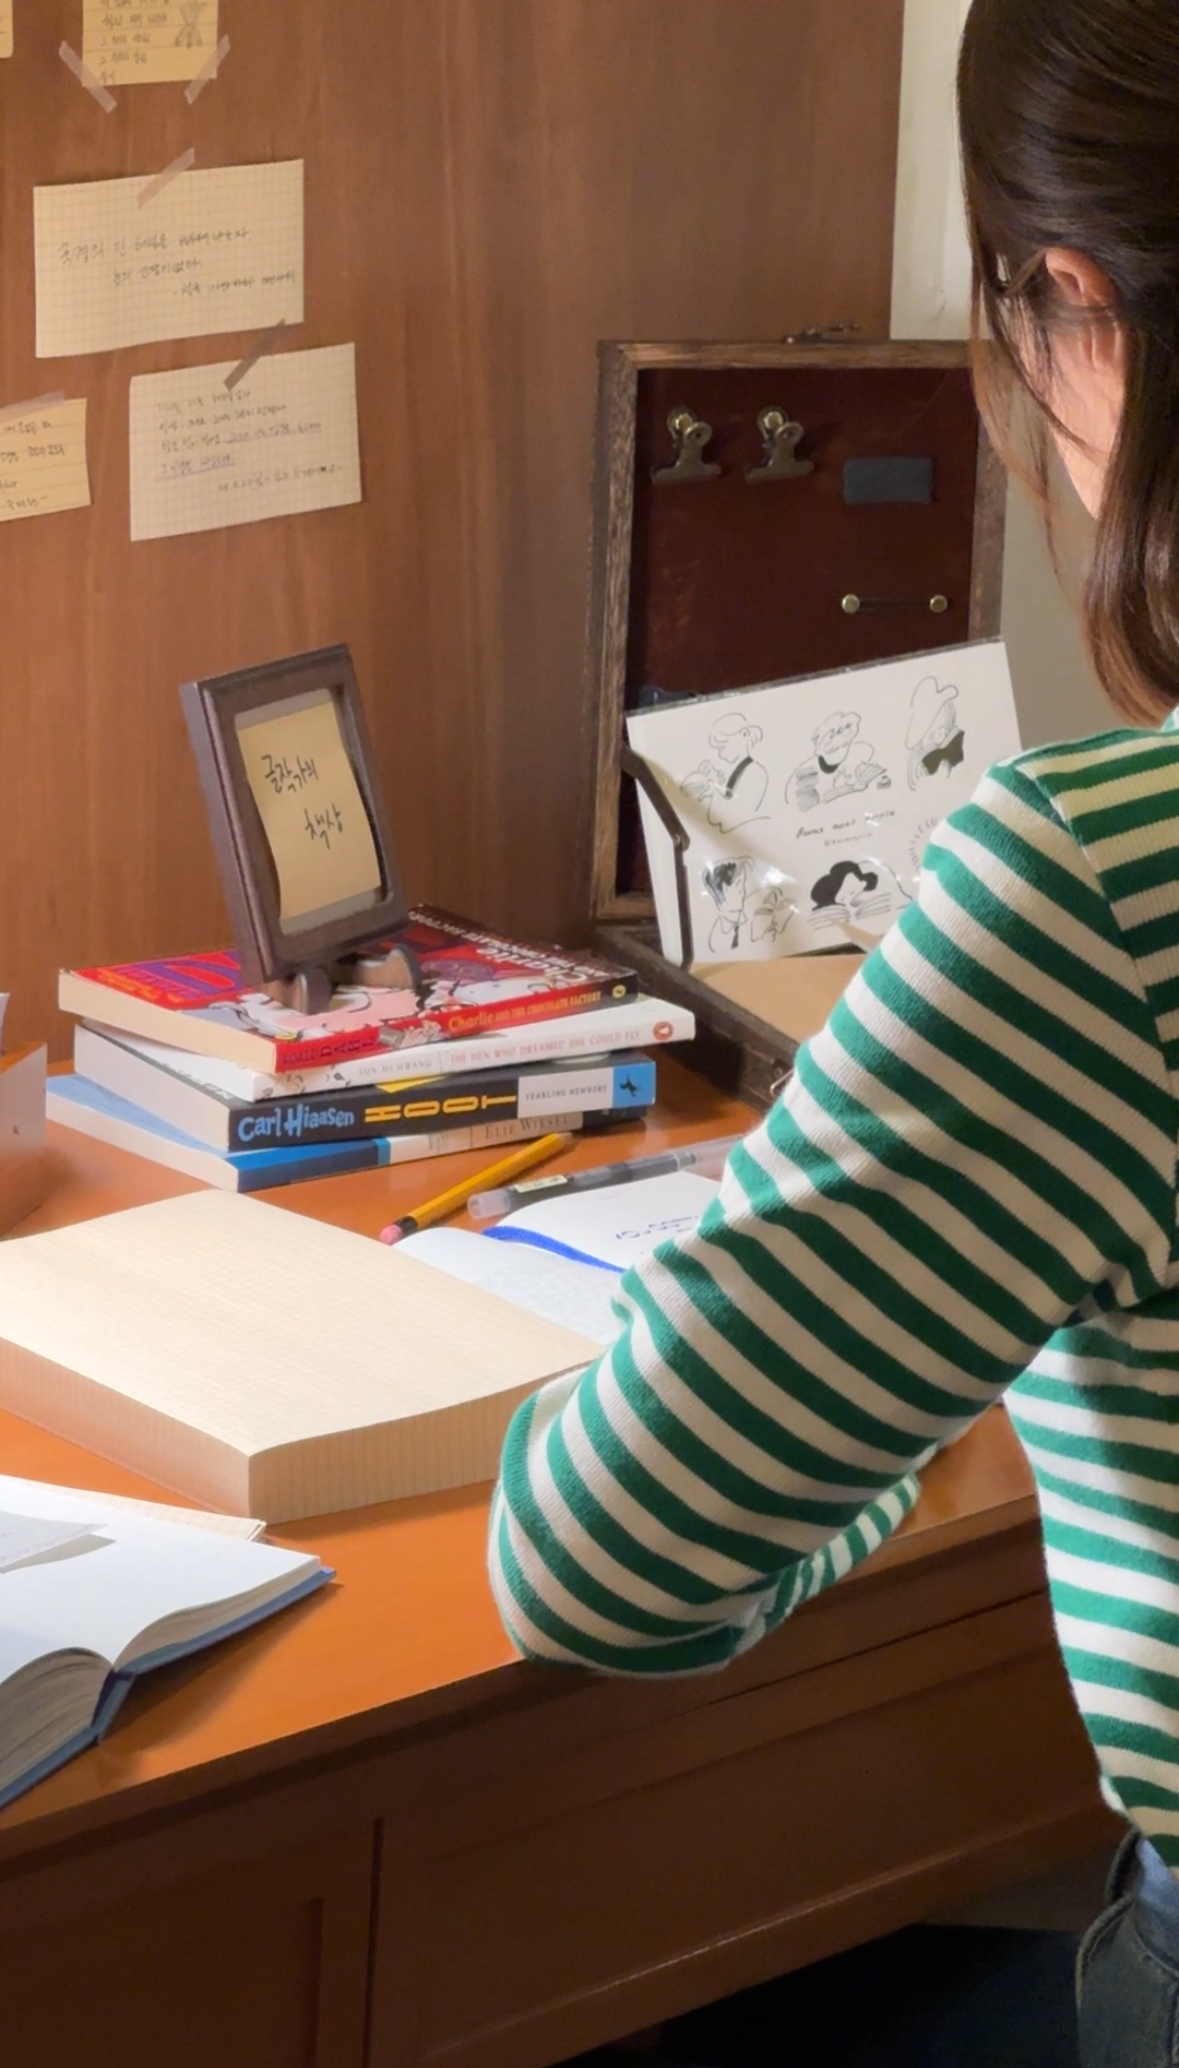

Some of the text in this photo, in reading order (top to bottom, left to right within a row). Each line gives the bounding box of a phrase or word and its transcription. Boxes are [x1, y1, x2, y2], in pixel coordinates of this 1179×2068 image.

[261, 754, 319, 794] 글작가의
[304, 802, 343, 850] 책상
[448, 1010, 494, 1031] Charlie
[570, 990, 602, 1006] FACTORY
[451, 1055, 466, 1064] THE
[471, 1051, 490, 1062] HEN
[494, 1046, 516, 1058] WHO
[589, 1033, 621, 1046] COULD
[624, 1030, 640, 1041] FLY
[364, 1095, 517, 1123] HOOT
[525, 1089, 566, 1101] YEARLING
[238, 1103, 355, 1142] Carl Hiaasen
